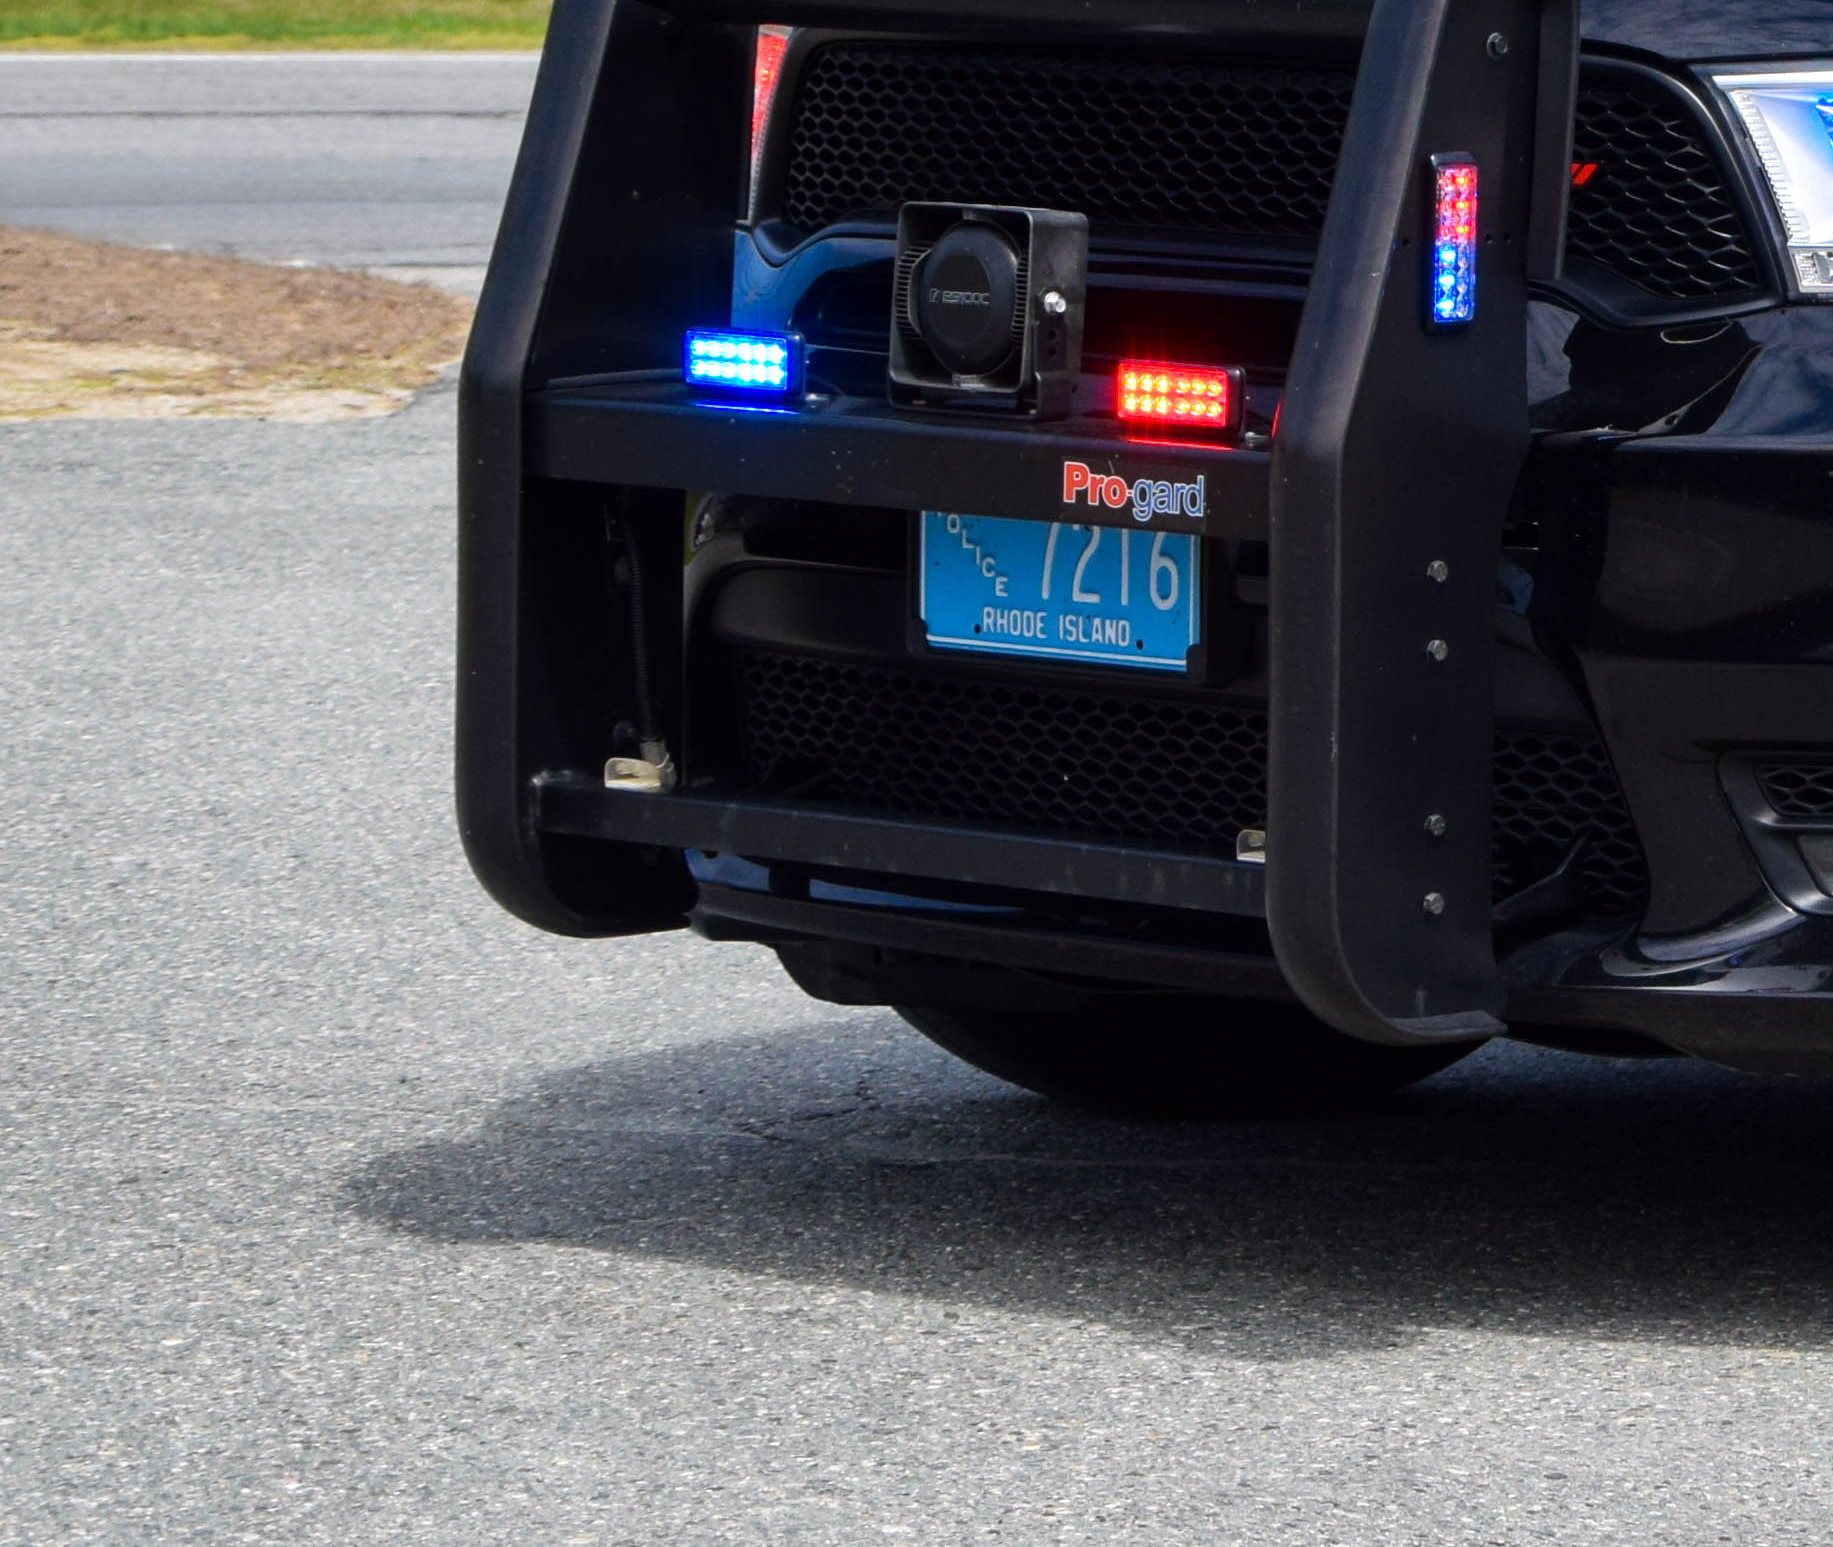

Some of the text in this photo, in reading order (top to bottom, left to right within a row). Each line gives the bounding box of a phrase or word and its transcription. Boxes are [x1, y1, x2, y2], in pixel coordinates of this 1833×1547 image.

[1063, 461, 1204, 522] Pro-gard
[936, 511, 1009, 597] OLICE
[1041, 522, 1179, 611] 7216
[983, 606, 1131, 647] RHODE ISLAND
